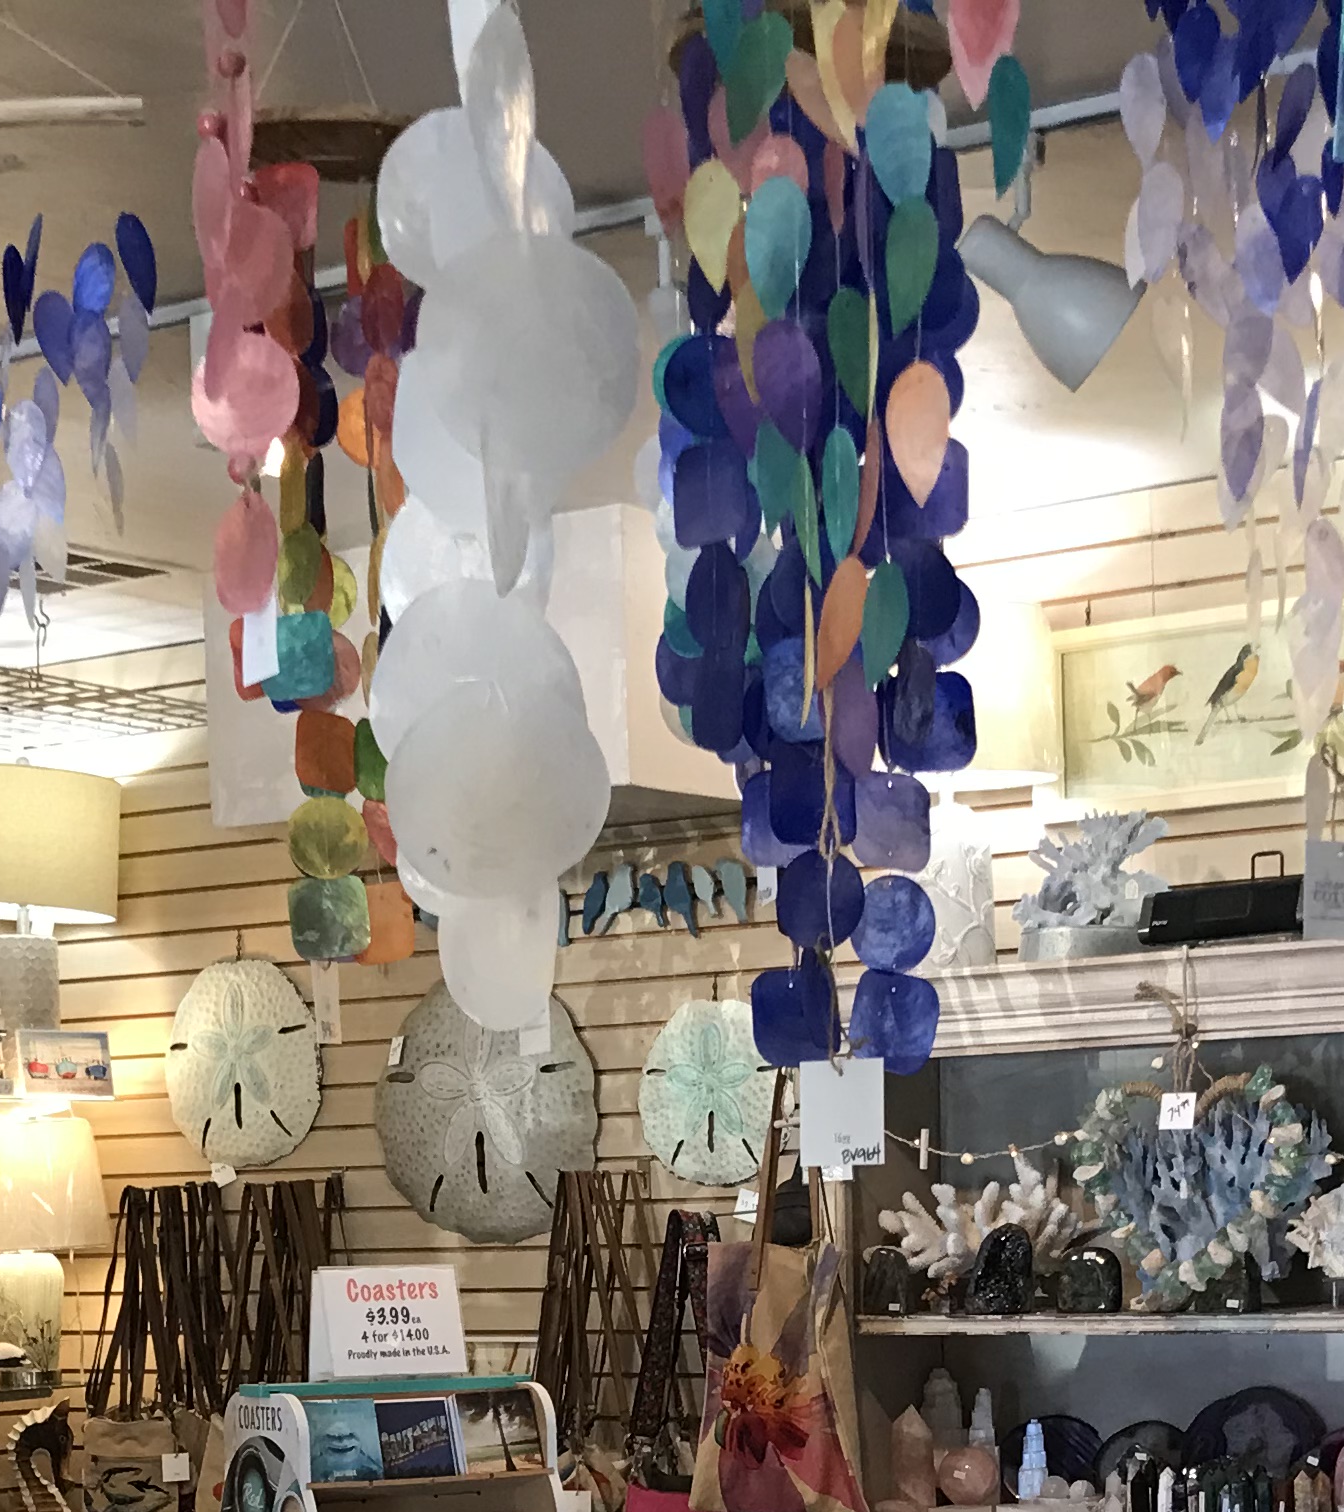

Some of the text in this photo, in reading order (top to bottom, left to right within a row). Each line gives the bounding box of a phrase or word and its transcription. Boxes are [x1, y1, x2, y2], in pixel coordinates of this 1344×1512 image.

[346, 1278, 439, 1303] Coasters
[365, 1306, 422, 1326] $3.99 ea
[361, 1330, 370, 1344] 4
[372, 1330, 389, 1343] for
[347, 1349, 378, 1360] Proudly
[380, 1347, 401, 1358] made
[402, 1346, 411, 1357] in
[412, 1345, 426, 1356] the
[238, 1404, 284, 1432] COASTERS
